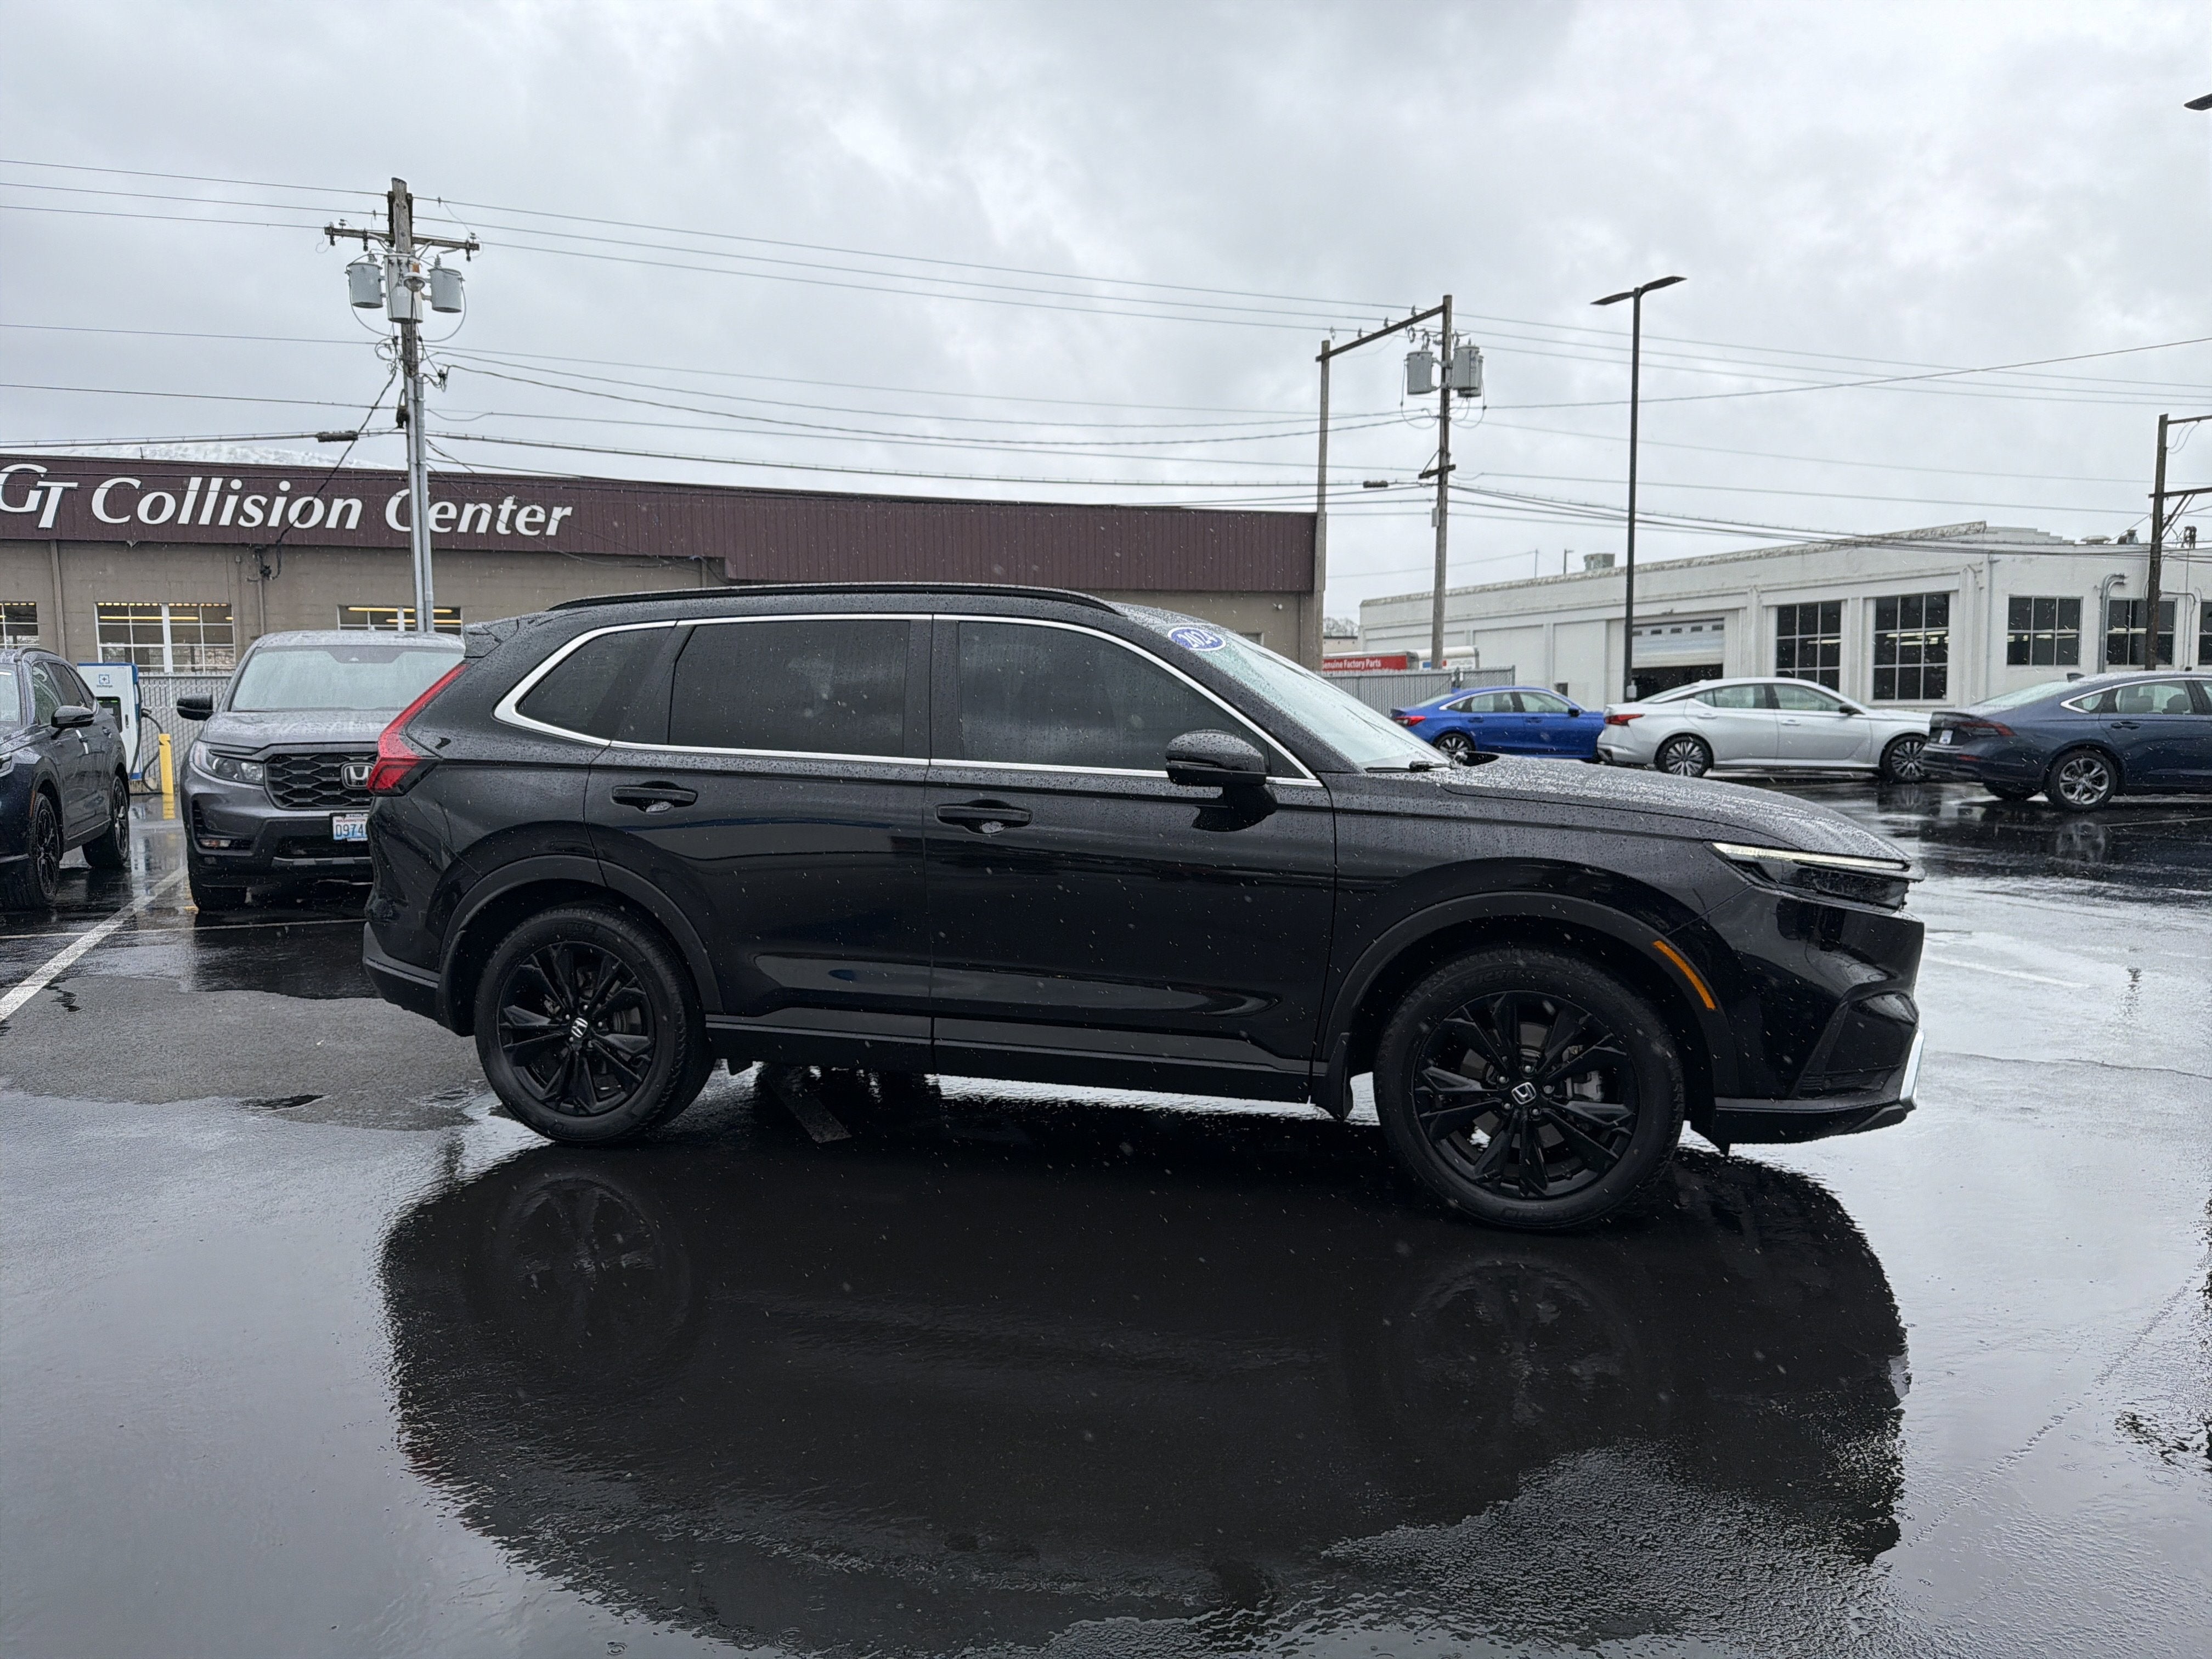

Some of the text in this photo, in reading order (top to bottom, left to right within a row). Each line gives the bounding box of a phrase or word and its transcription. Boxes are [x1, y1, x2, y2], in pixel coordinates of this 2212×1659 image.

[0, 464, 573, 535] GT Collision Center
[1177, 631, 1217, 648] 2024
[1344, 659, 1365, 670] Factory
[1365, 658, 1381, 668] Parts
